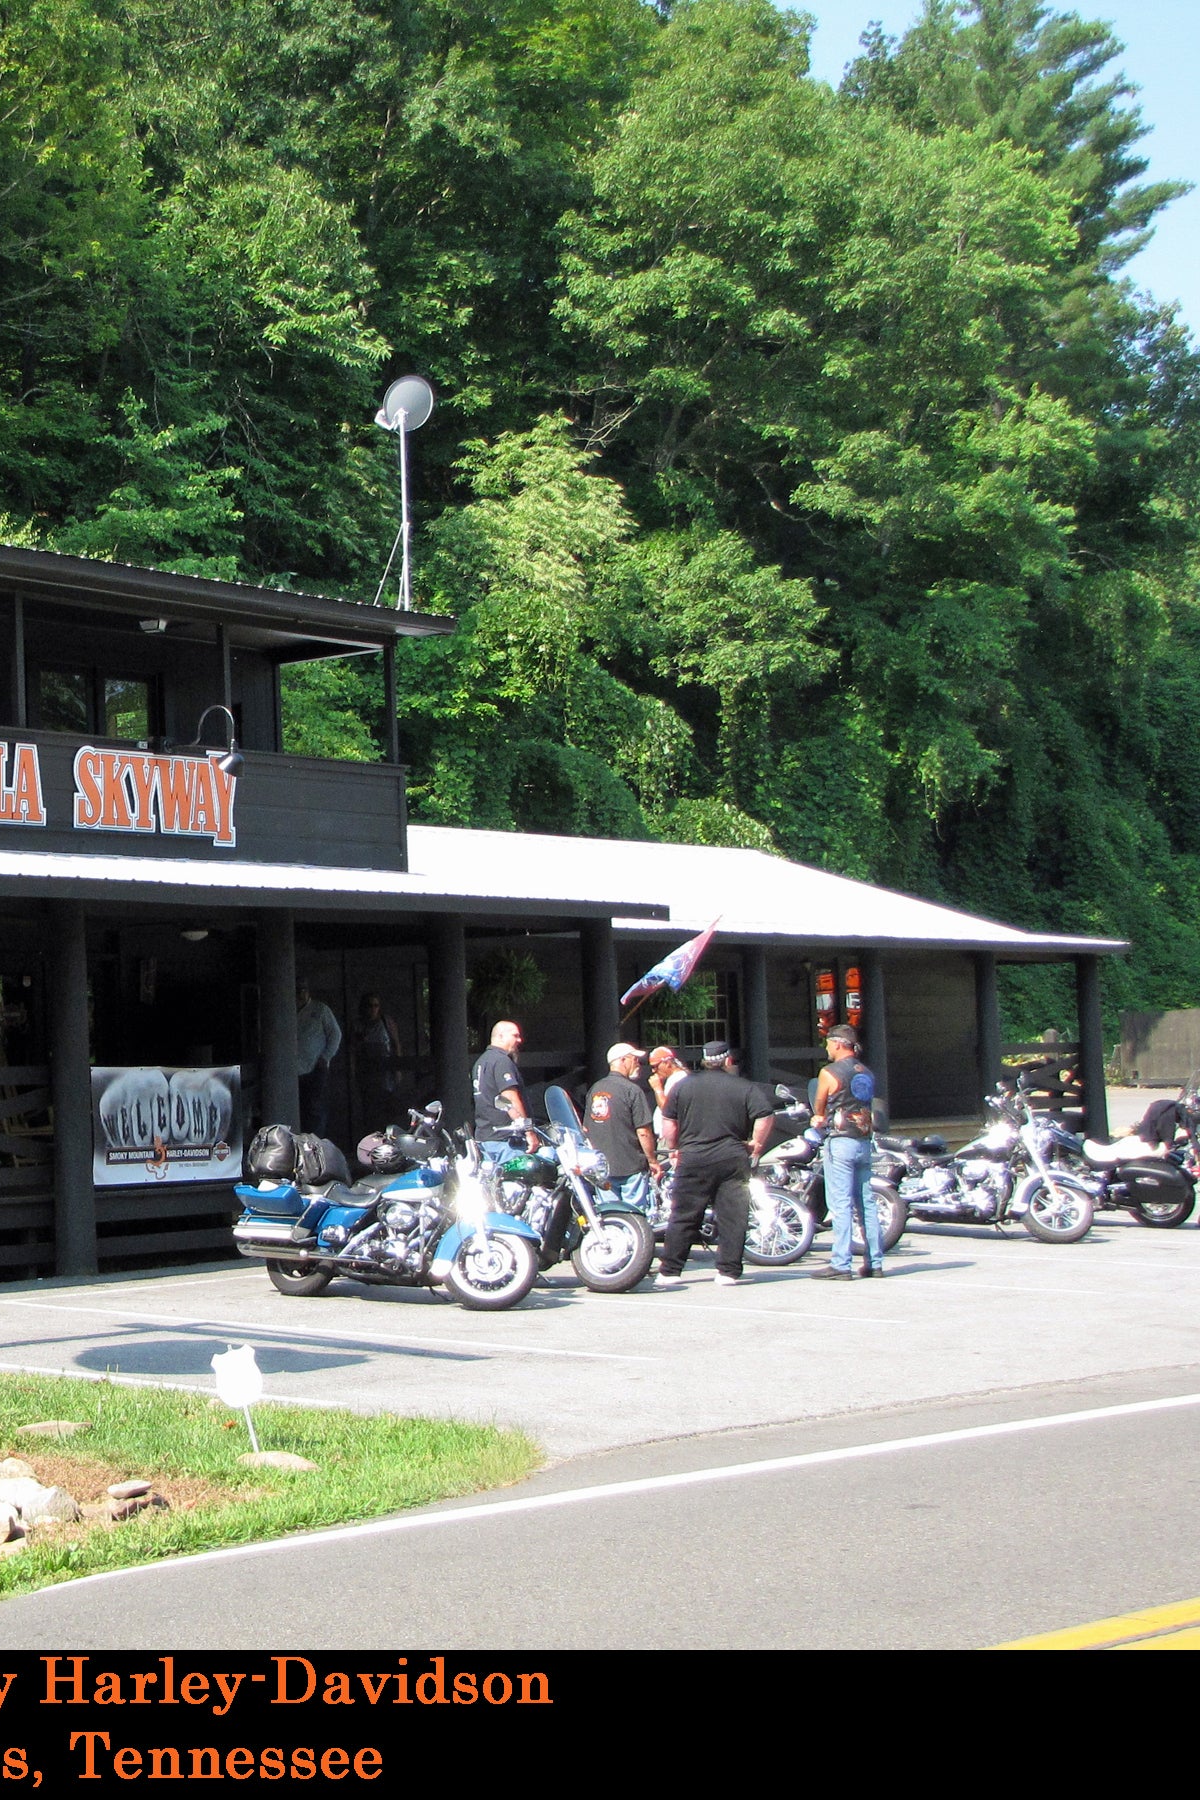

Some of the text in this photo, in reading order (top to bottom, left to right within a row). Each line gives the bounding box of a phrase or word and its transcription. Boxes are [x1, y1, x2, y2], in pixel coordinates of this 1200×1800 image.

[75, 747, 237, 845] SKYWAY
[102, 1093, 219, 1145] WELCOME
[109, 1151, 127, 1161] SMOKY
[128, 1150, 155, 1160] MOUNTAIN
[166, 1148, 210, 1158] HARLEY-DAVIDSON
